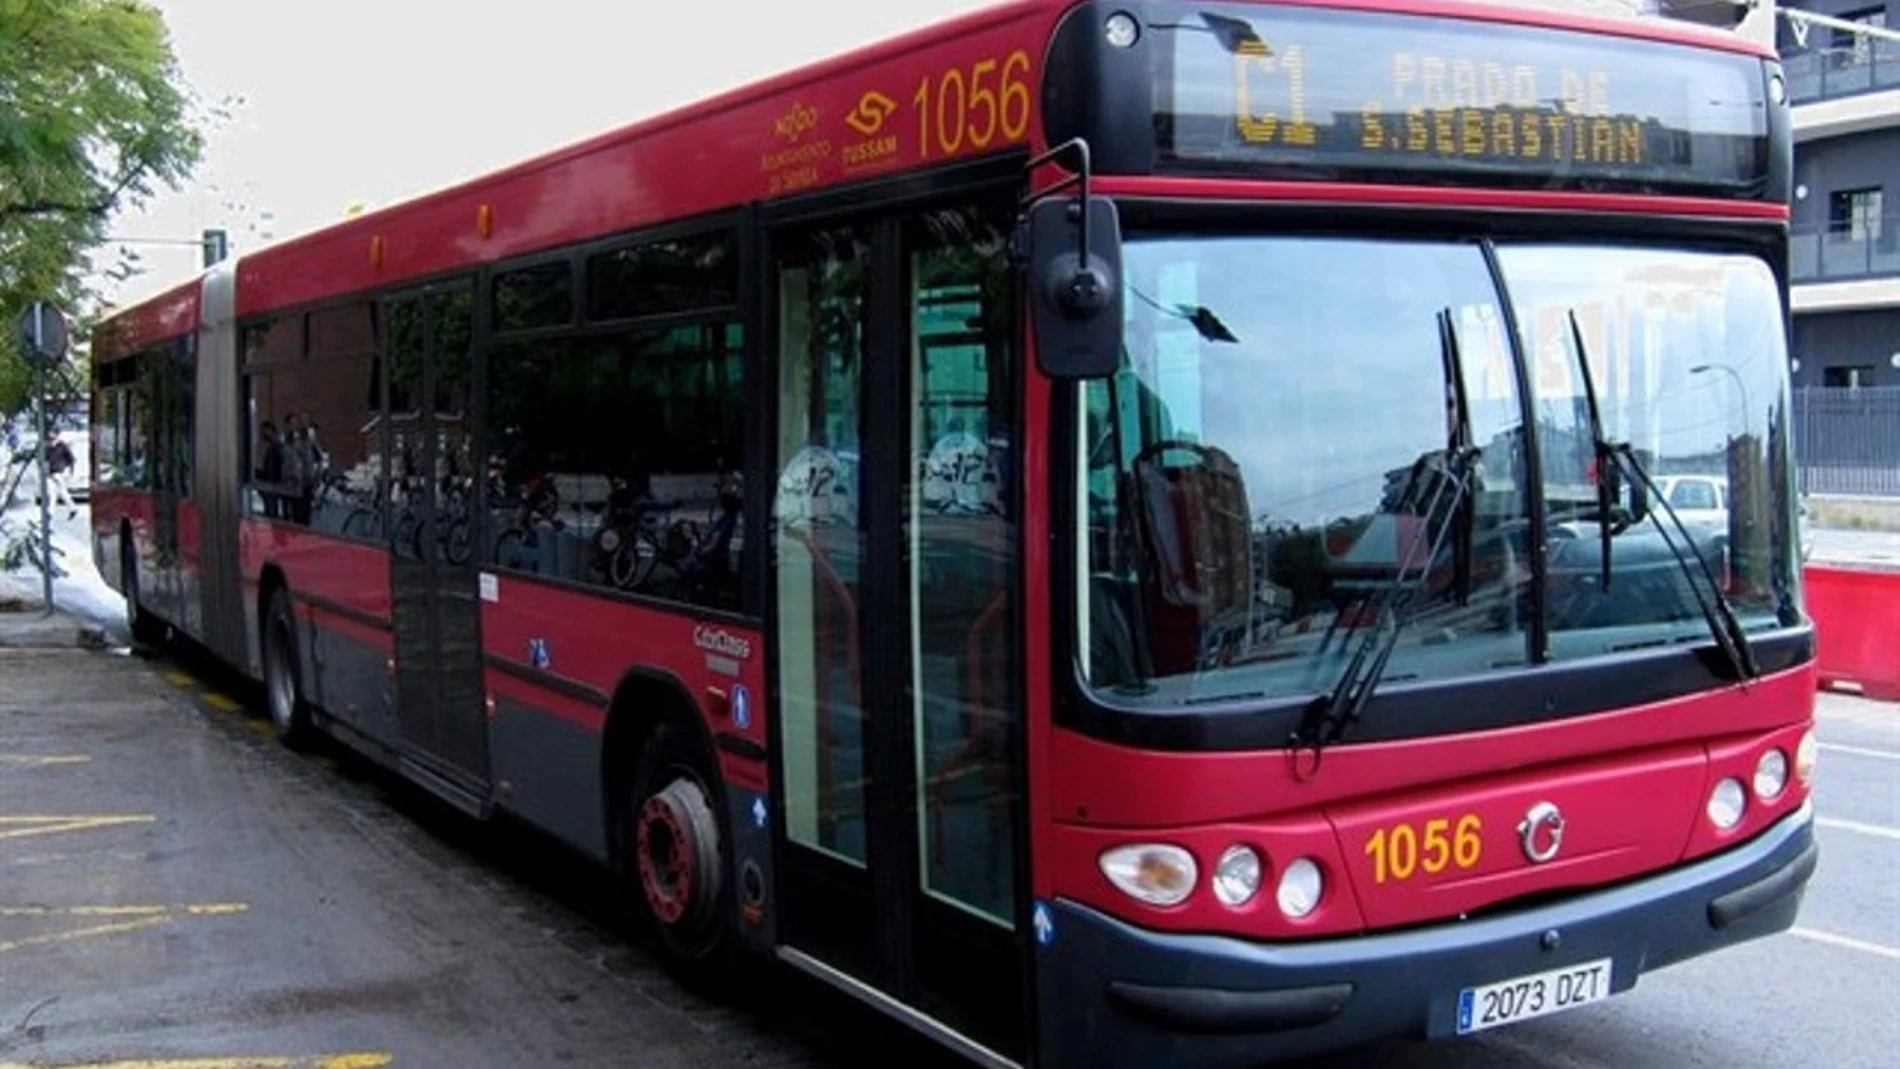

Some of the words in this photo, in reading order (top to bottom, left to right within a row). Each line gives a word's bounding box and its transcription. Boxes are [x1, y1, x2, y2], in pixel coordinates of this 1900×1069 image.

[913, 51, 1030, 157] 1056
[1235, 41, 1316, 145] C1
[1392, 52, 1537, 108] PRADO
[1365, 814, 1482, 883] 1056
[1481, 980, 1546, 1024] 2073
[1556, 966, 1601, 1006] DZT
